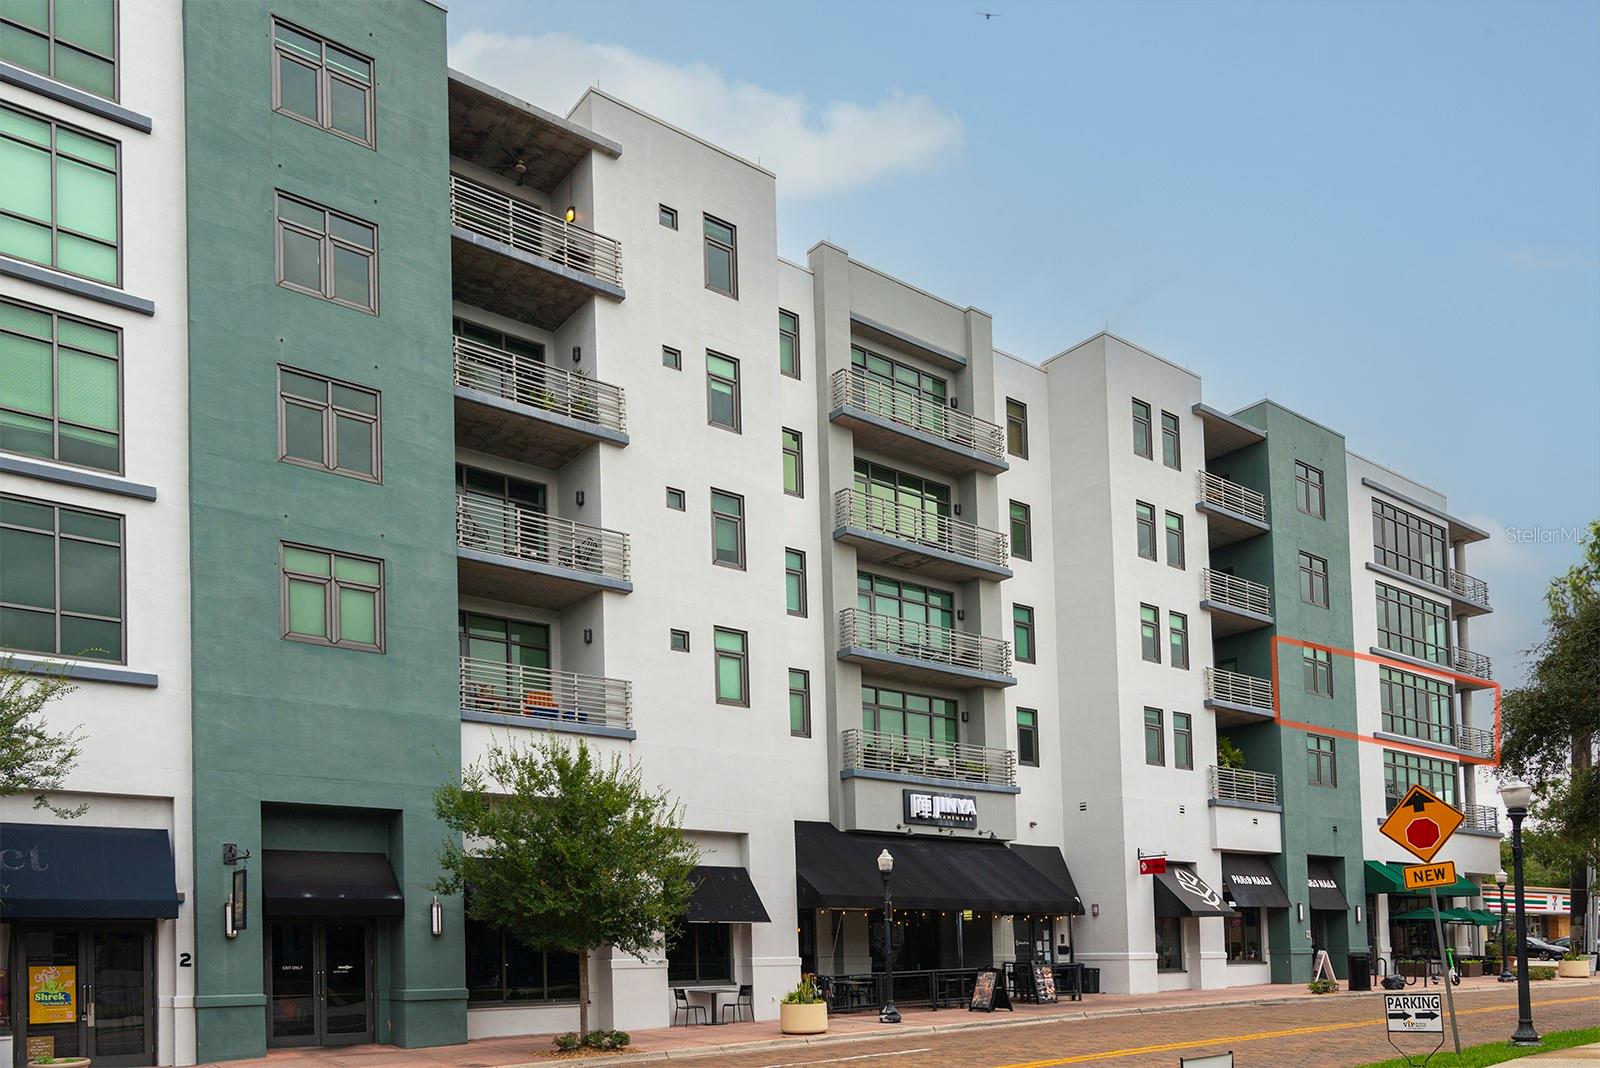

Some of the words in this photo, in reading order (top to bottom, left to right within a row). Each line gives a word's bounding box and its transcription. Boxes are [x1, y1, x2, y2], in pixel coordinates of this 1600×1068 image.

[932, 796, 977, 818] JINYA
[1413, 867, 1445, 883] NEW
[180, 953, 192, 967] 2
[34, 993, 66, 1001] Shrek
[1387, 996, 1440, 1009] PARKING
